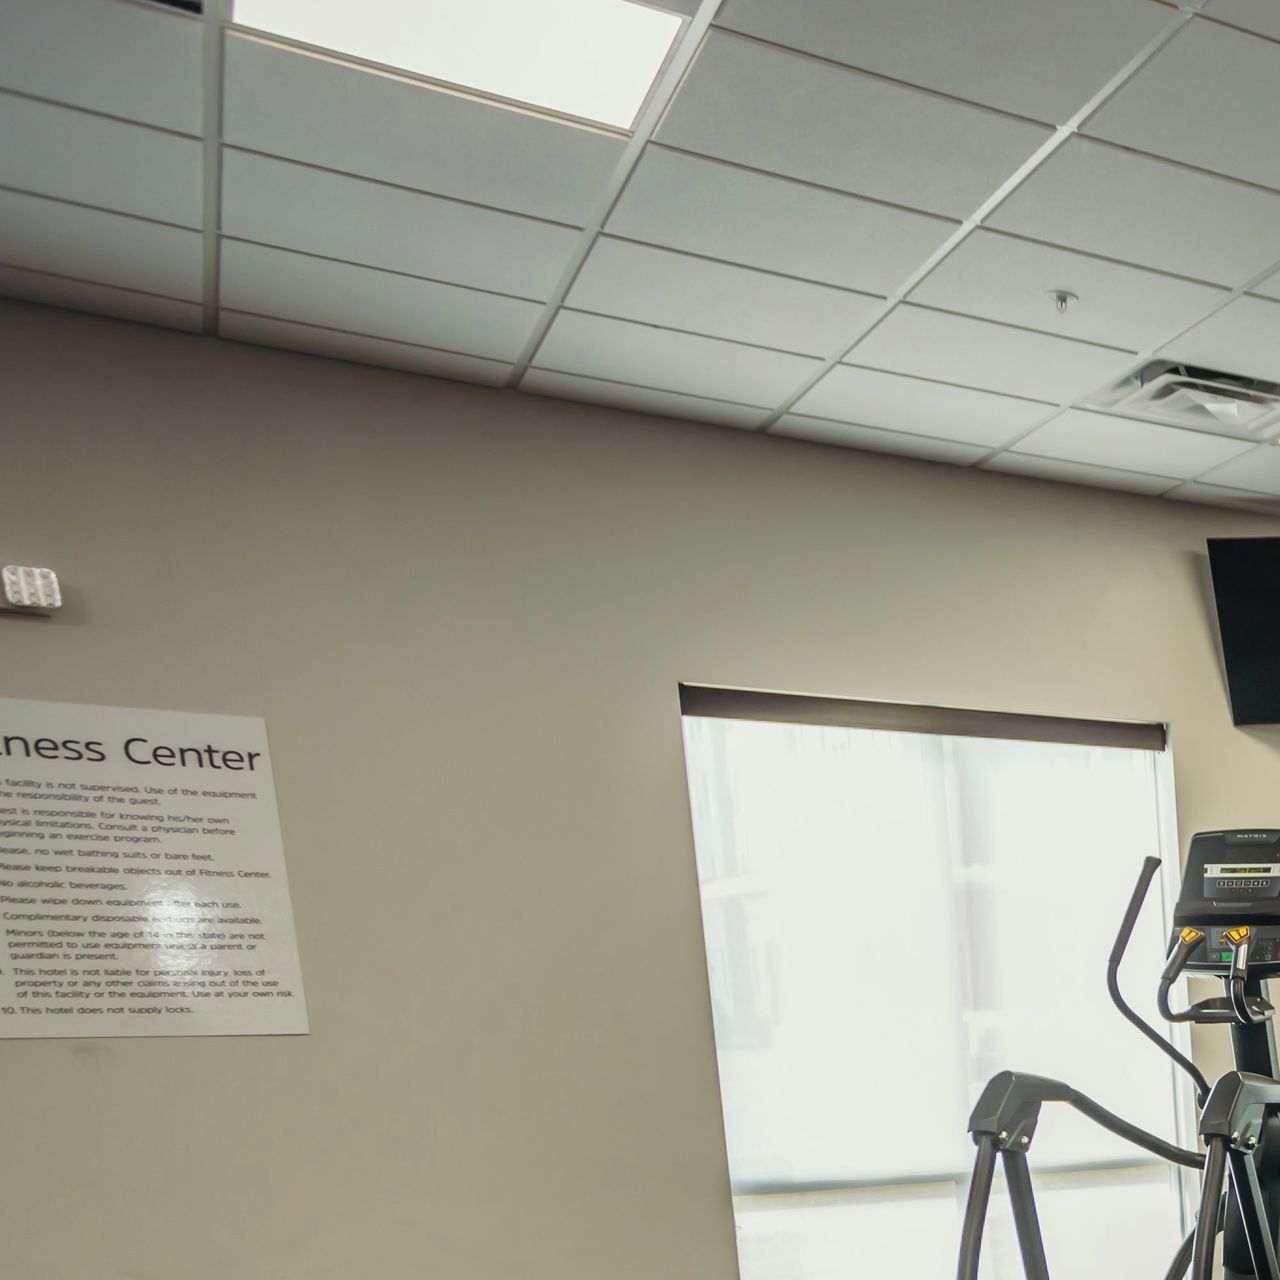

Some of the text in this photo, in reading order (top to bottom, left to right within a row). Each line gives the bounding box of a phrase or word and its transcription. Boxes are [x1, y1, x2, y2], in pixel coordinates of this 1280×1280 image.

[0, 735, 261, 771] ness Center
[6, 778, 42, 790] facility
[58, 782, 77, 790] not
[80, 784, 140, 793] supervised.
[144, 785, 165, 795] Use
[202, 790, 258, 800] equipment
[16, 792, 90, 804] responsibility
[129, 798, 161, 806] guest.
[34, 809, 97, 818] responsible
[119, 811, 164, 823] knowing
[168, 813, 203, 823] his/her
[35, 819, 94, 829] limitations.
[98, 821, 138, 831] Consult
[152, 824, 198, 834] physician
[202, 826, 236, 835] before
[66, 833, 110, 841] exercise
[114, 835, 162, 844] program.
[53, 848, 74, 856] wet
[78, 848, 120, 859] bathing
[122, 850, 147, 858] suits
[165, 851, 189, 860] bare
[35, 863, 62, 874] keep
[65, 864, 120, 874] breakable
[123, 866, 162, 876] objects
[200, 868, 235, 878] Fitness
[17, 879, 66, 888] alcoholic
[69, 880, 128, 891] beverages.
[0, 895, 38, 904] Please
[40, 897, 68, 906] wipe
[71, 897, 103, 906] down
[106, 899, 163, 908] equipment
[194, 900, 219, 908] each
[2, 912, 89, 923] Complimentary
[91, 914, 149, 924] disposable
[217, 916, 263, 924] available.
[6, 928, 44, 937] Minors
[47, 929, 85, 939] (below
[88, 929, 107, 938] the
[8, 941, 64, 950] permitted
[104, 942, 162, 950] equipment
[210, 942, 243, 950] parent
[10, 951, 60, 960] guardian
[13, 968, 36, 976] This
[39, 968, 68, 976] hotel
[104, 968, 132, 976] liable
[153, 968, 199, 978] personal
[233, 968, 253, 976] loss
[15, 980, 64, 989] property
[82, 981, 102, 989] any
[105, 979, 134, 987] other
[137, 979, 170, 987] claims
[172, 980, 206, 989] arising
[32, 990, 52, 998] this
[55, 990, 90, 1000] facility
[108, 990, 127, 998] the
[191, 990, 211, 998] Use
[19, 1006, 42, 1014] This
[46, 1006, 74, 1014] hotel
[77, 1006, 104, 1014] does
[127, 1006, 162, 1016] supply
